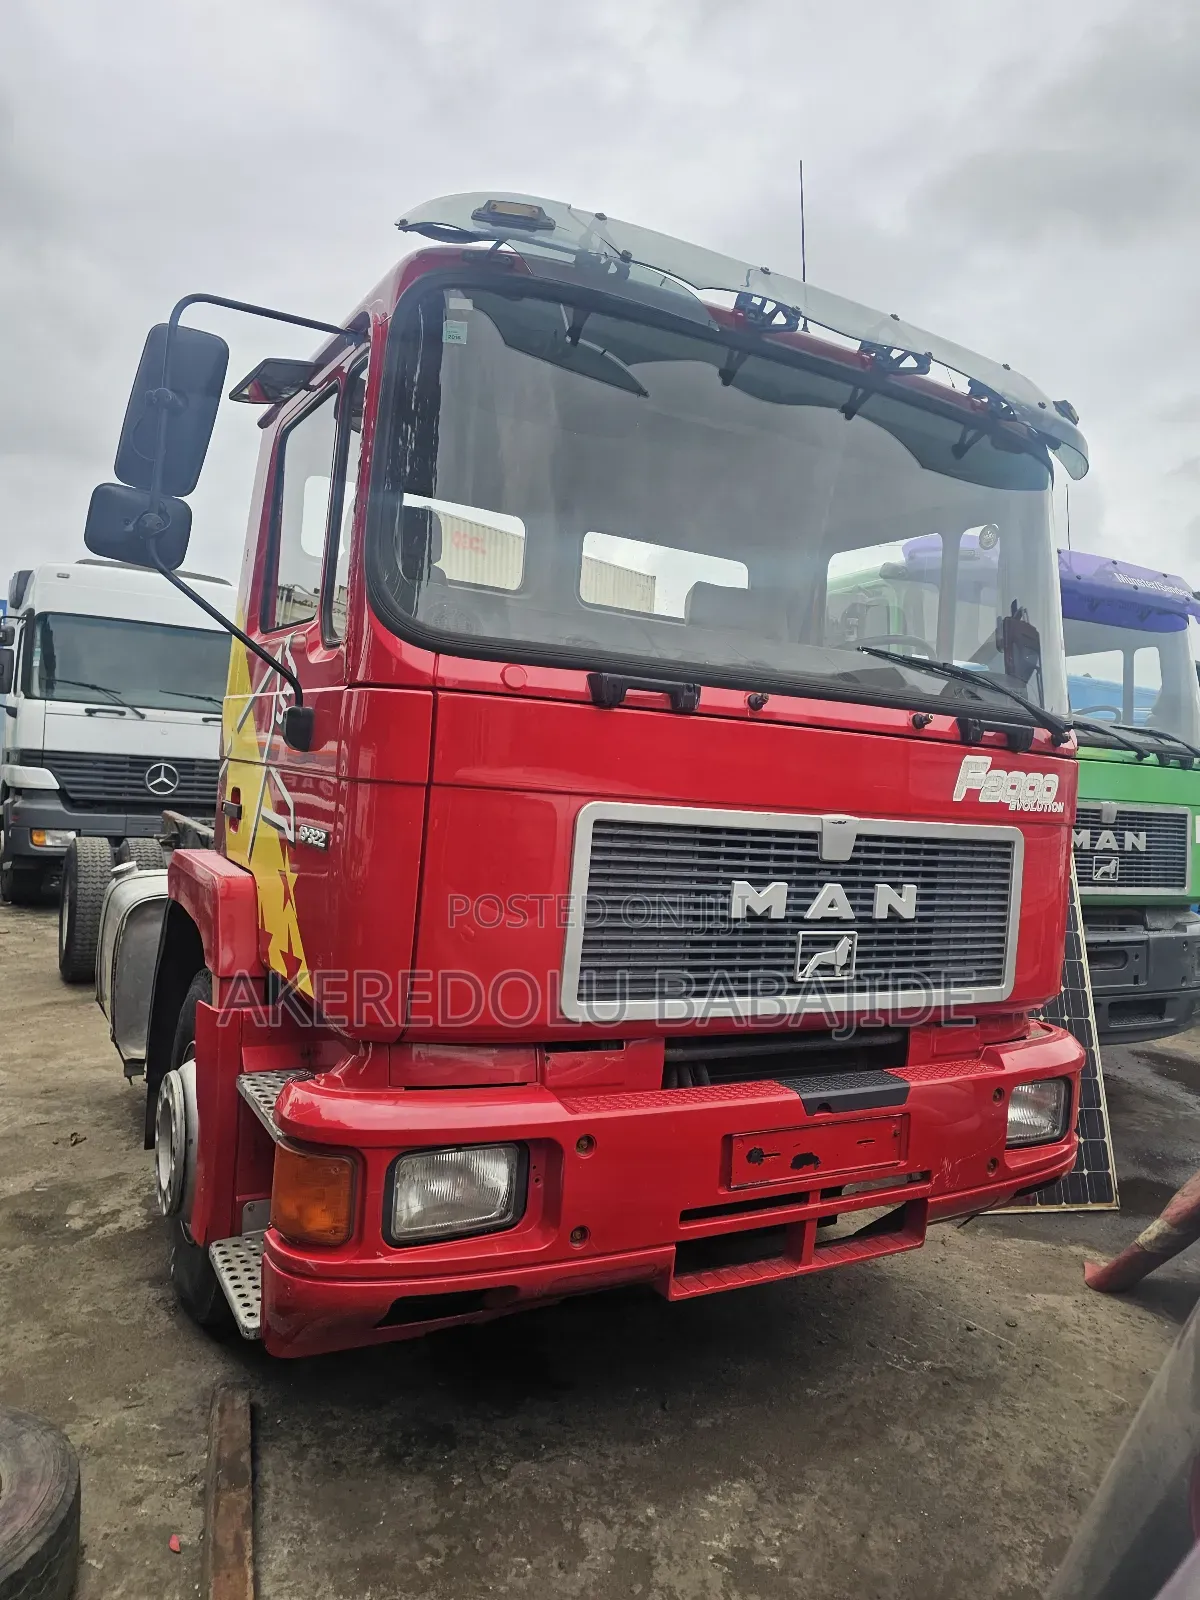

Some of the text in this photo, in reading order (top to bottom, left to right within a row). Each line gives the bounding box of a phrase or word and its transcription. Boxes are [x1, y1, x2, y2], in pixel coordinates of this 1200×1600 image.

[953, 755, 1059, 803] F2000
[1008, 800, 1064, 813] EVOLUTION
[1072, 828, 1147, 851] MAN
[731, 880, 917, 920] MAN
